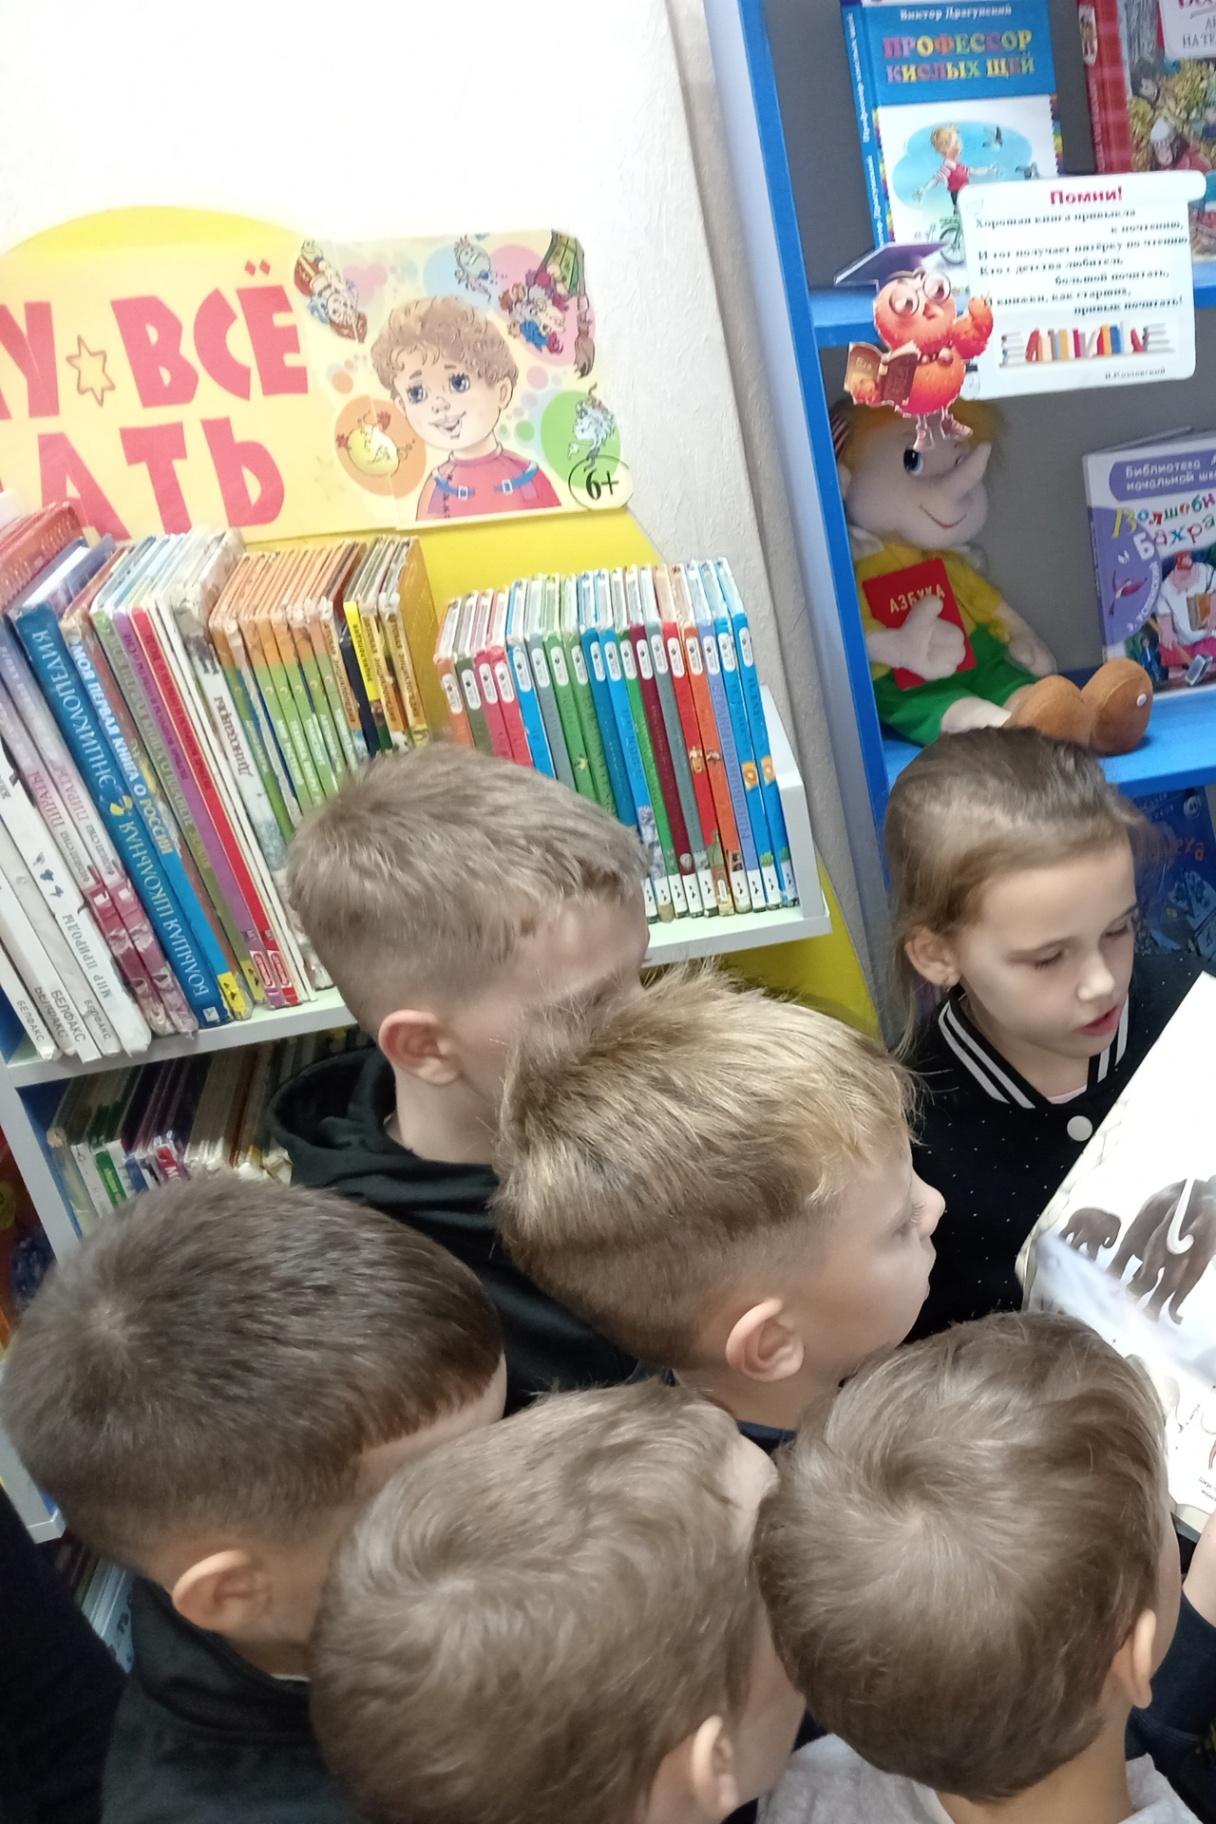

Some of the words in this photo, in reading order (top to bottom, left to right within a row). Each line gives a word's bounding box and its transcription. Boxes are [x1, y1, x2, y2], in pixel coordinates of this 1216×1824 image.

[883, 30, 1032, 58] ПРОФЕССОР
[886, 60, 981, 82] КИСЛЫХ
[986, 52, 1035, 79] ЩЕЙ
[1049, 186, 1123, 205] Помни!
[0, 300, 60, 418] У
[110, 259, 308, 408] ВСЁ
[586, 471, 619, 499] 6+
[1125, 460, 1201, 479] Библиотека
[1126, 472, 1195, 492] начальной
[31, 629, 118, 788] ЭНЦИКЛОПЕДИЯ
[69, 641, 95, 680] МОЯ
[88, 679, 120, 736] ПЕРВАЯ
[113, 734, 139, 781] КНИГА
[133, 783, 147, 797] О
[140, 797, 174, 855] РОССИИ
[215, 696, 254, 778] Динозавры
[118, 820, 172, 918] ШКОЛЬНАЯ
[60, 912, 99, 971] ПРИРОДЫ
[163, 918, 210, 998] БОЛЬШАЯ
[92, 971, 114, 1000] МИР
[15, 998, 45, 1043] БЕЛФАКС
[50, 988, 88, 1045] БЕЛФАКС
